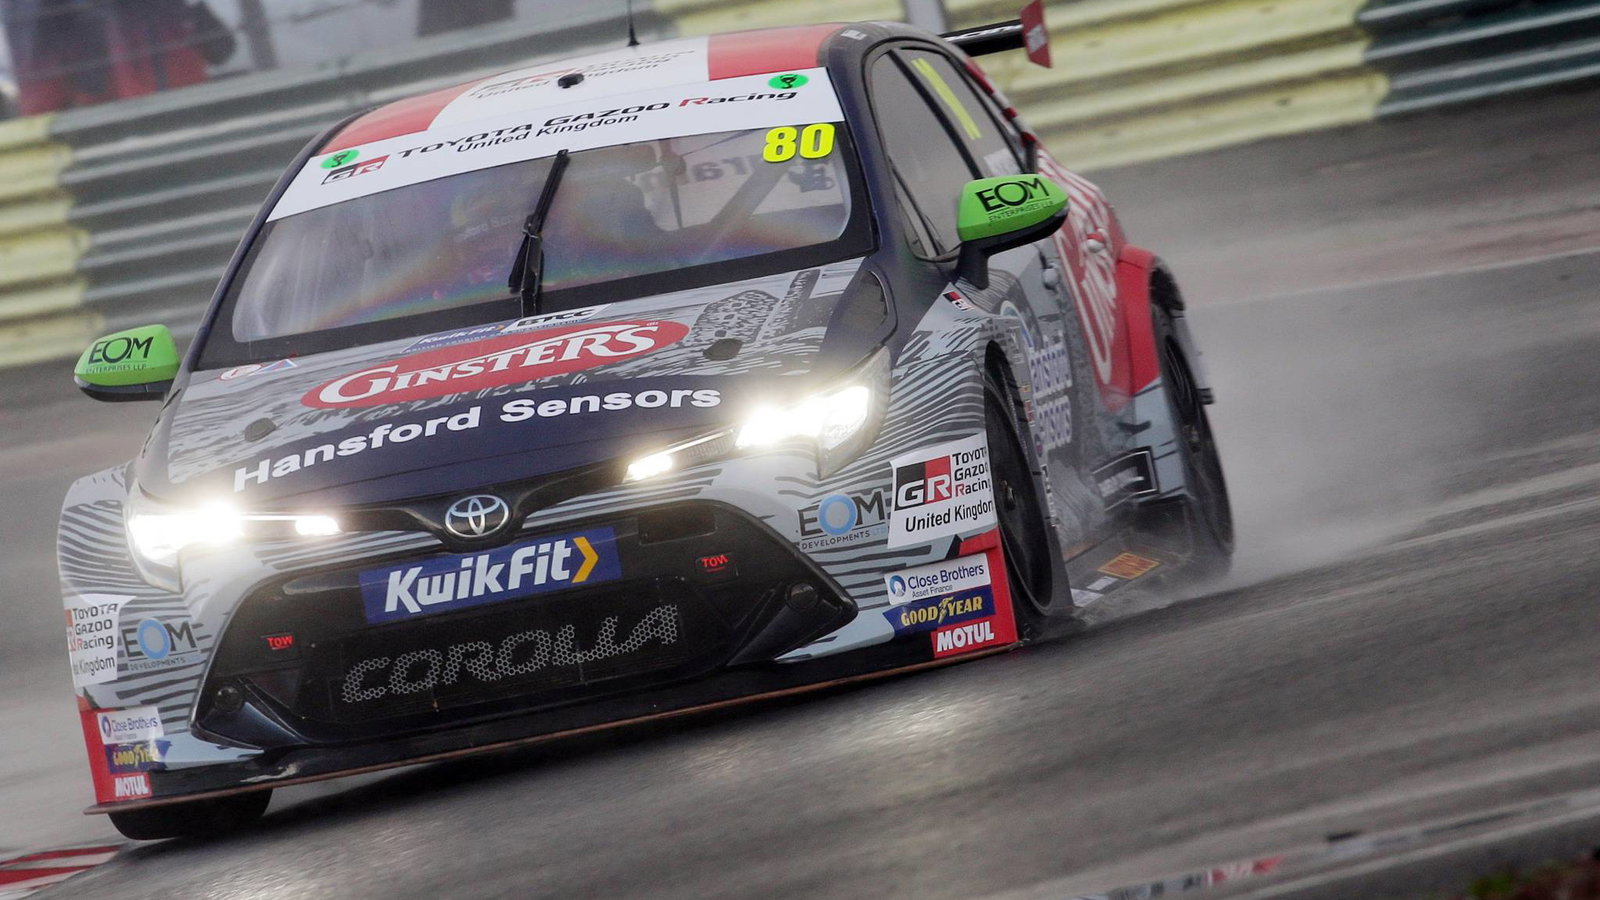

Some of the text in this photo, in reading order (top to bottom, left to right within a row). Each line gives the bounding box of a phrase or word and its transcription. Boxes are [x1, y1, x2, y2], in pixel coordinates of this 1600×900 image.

[399, 91, 798, 159] TOYOTA GAZOO Racing
[457, 114, 639, 153] United Kingdom
[762, 123, 835, 163] 80
[975, 178, 1050, 212] EOM
[88, 337, 154, 364] EOM
[234, 389, 721, 493] Hansford Sensors
[896, 474, 951, 508] GR
[799, 488, 885, 536] EOM
[906, 508, 951, 533] United
[801, 530, 870, 549] DEVELOPMENTS
[702, 554, 728, 568] TOW
[908, 564, 985, 590] Close Brothers
[912, 583, 953, 598] Asset Finance
[72, 603, 118, 620] TOYOTA
[901, 596, 983, 627] GOODYEAR
[75, 619, 112, 635] GAZOO
[122, 617, 197, 660] EOM
[937, 621, 995, 652] MOTUL
[77, 635, 114, 651] Racing
[265, 634, 293, 648] TOW
[343, 604, 678, 703] COROLLA
[79, 656, 115, 676] Kingdom
[129, 657, 187, 671] DEVELOPMENTS
[127, 717, 158, 730] Brothers
[115, 775, 149, 797] MOTUL
